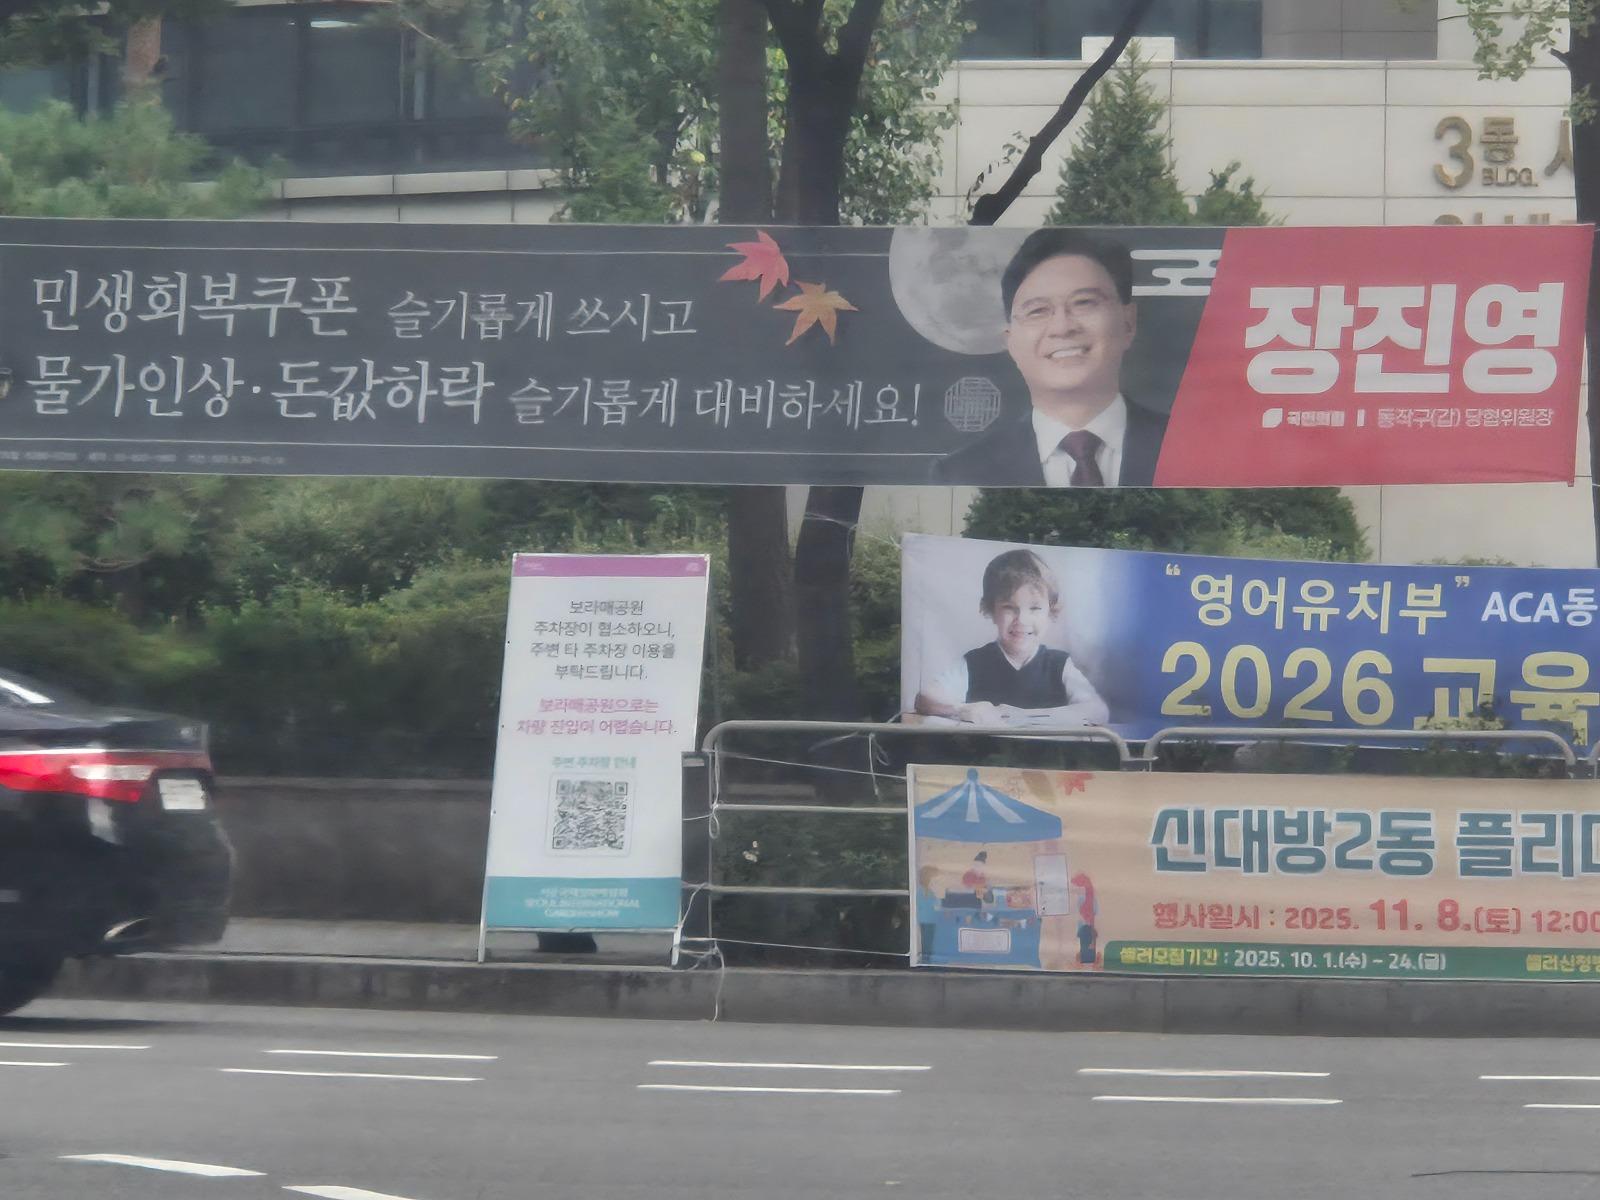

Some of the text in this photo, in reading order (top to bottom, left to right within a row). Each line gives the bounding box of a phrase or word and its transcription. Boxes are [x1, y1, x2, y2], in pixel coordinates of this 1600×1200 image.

[1433, 115, 1519, 190] 3동
[33, 269, 698, 343] 민생회복쿠폰 슬기롭게 쓰시고
[1244, 281, 1565, 395] 장진영
[509, 376, 679, 429] 슬기롭게
[695, 378, 921, 431] 대비하세요!
[569, 600, 644, 616] 보라매공원
[533, 621, 676, 638] 주차장이 협소하오니,
[564, 643, 579, 659] 타
[583, 643, 627, 659] 주차장
[554, 664, 648, 681] 부탁드립니다.
[1160, 640, 1600, 747] 2026 교육
[550, 719, 594, 736] 진입이
[599, 719, 678, 735] 어렵습니다.
[1150, 807, 1436, 877] 신대방2동
[1152, 902, 1260, 931] 행사일시
[1284, 906, 1360, 931] 2025.
[1369, 898, 1423, 932] 11.
[1234, 949, 1285, 968] 2025.
[1290, 951, 1317, 968] 10.
